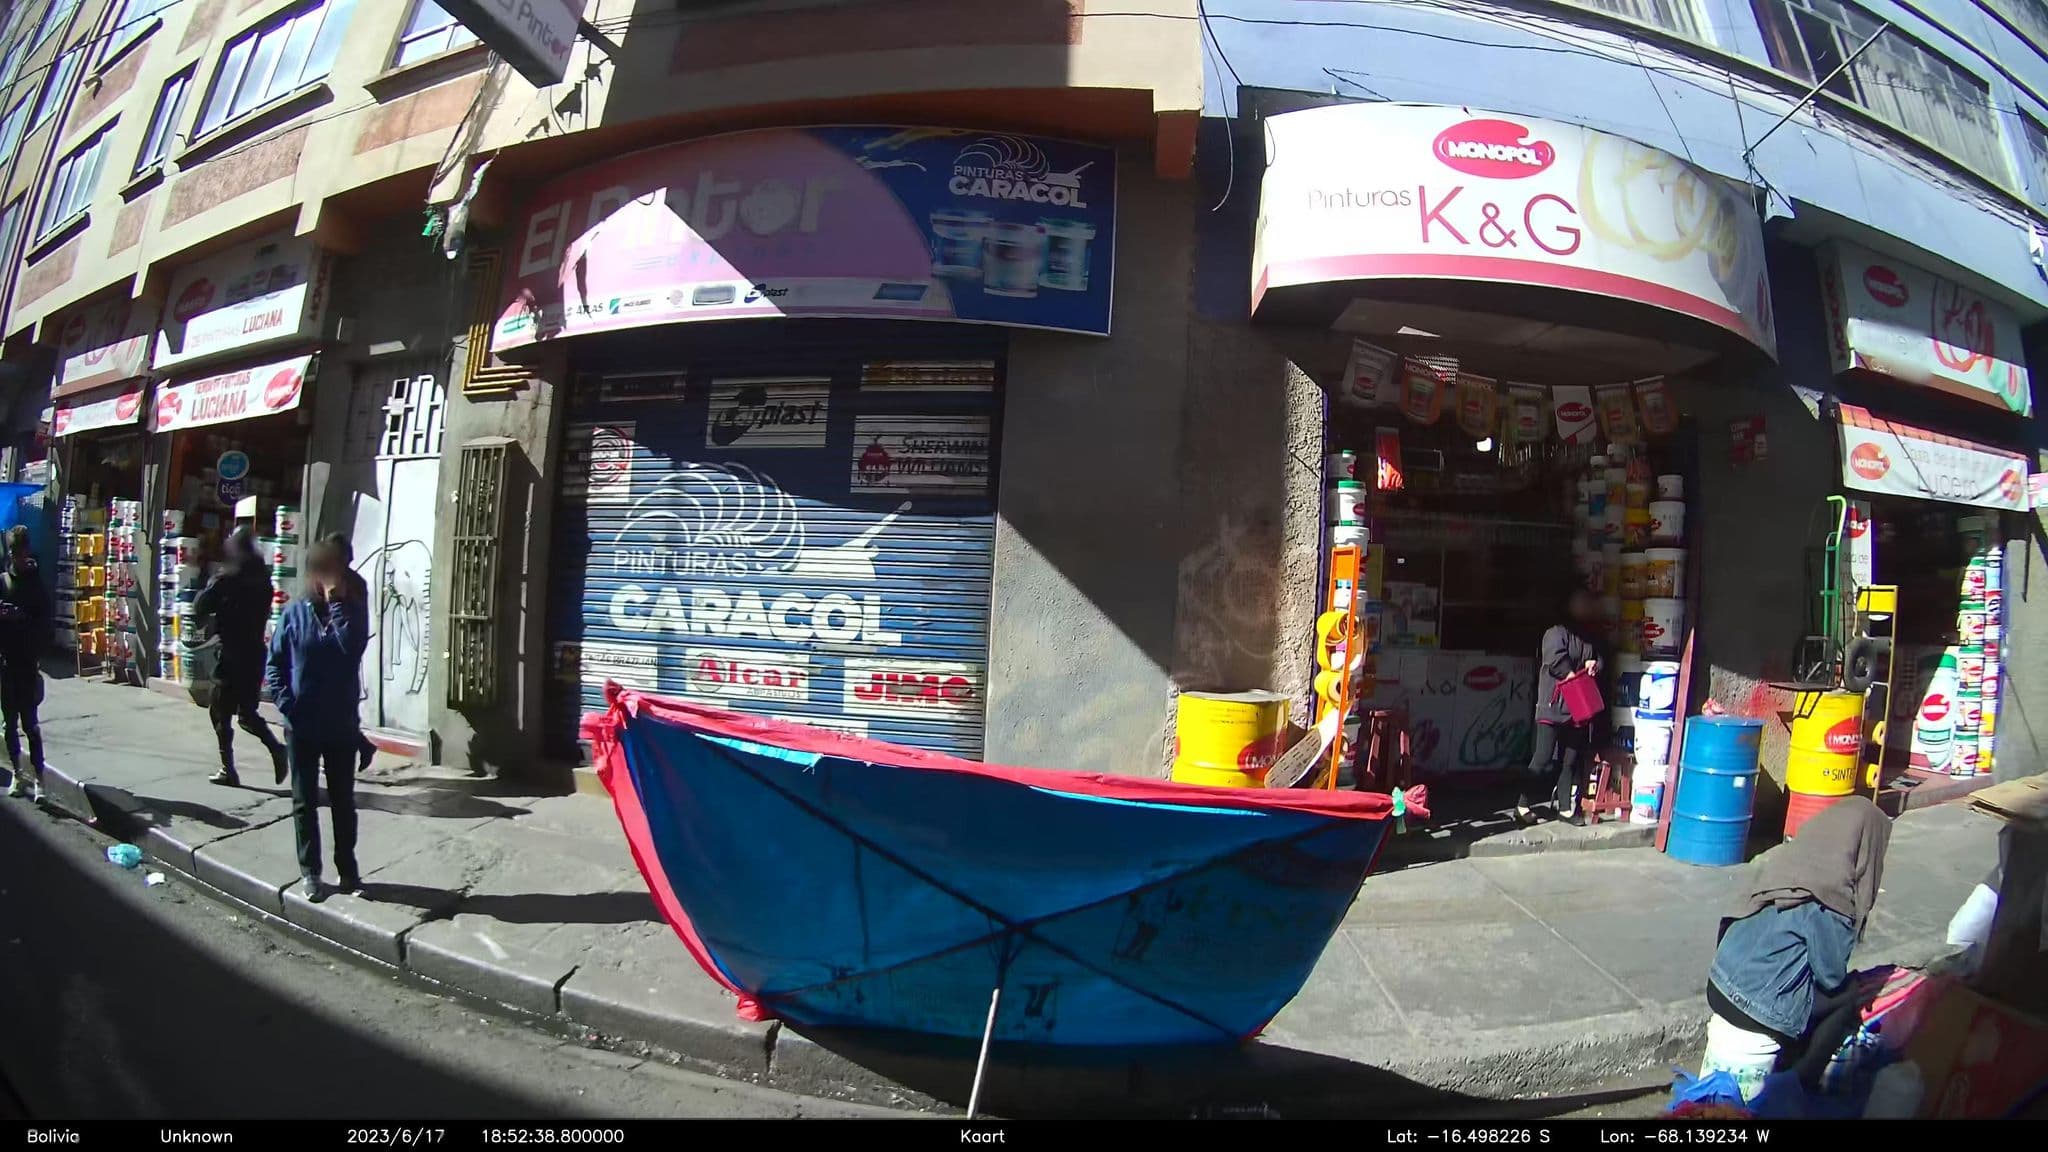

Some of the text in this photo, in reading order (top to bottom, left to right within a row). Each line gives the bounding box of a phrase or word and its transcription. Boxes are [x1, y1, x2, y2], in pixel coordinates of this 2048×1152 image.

[1448, 140, 1543, 166] MONOPOL
[953, 165, 1025, 181] PINTURAS
[949, 175, 1088, 209] CARACOL
[1308, 187, 1413, 209] Pinturas
[1418, 185, 1470, 245] K
[1523, 193, 1581, 256] G
[242, 308, 284, 334] LUCIANA
[191, 391, 247, 422] LUCIANA
[613, 549, 749, 578] PINTURAS
[609, 584, 903, 646] CARACOL
[697, 656, 807, 689] Alcar
